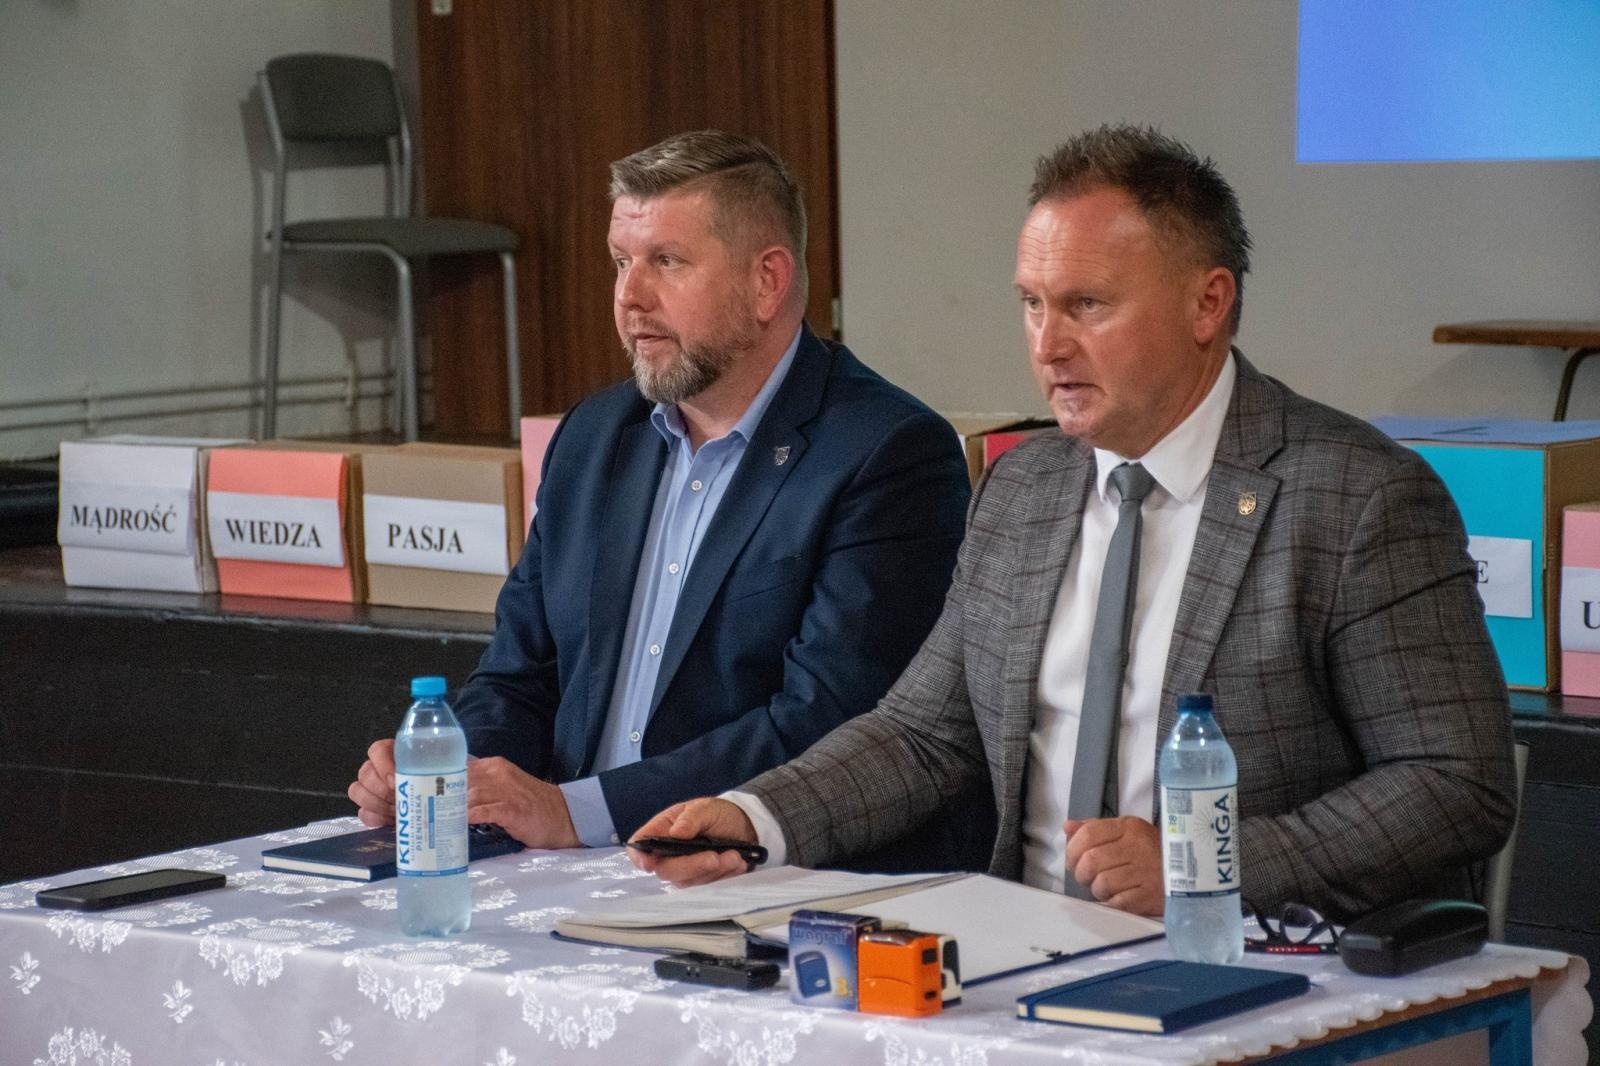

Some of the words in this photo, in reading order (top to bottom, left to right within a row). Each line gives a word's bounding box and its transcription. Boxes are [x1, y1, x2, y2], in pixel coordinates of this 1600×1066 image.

[71, 502, 178, 535] MĄDROŚĆ
[226, 520, 322, 551] WIEDZA
[387, 523, 464, 556] PASJA
[398, 780, 410, 865] KINGA
[1214, 793, 1233, 885] KINGA
